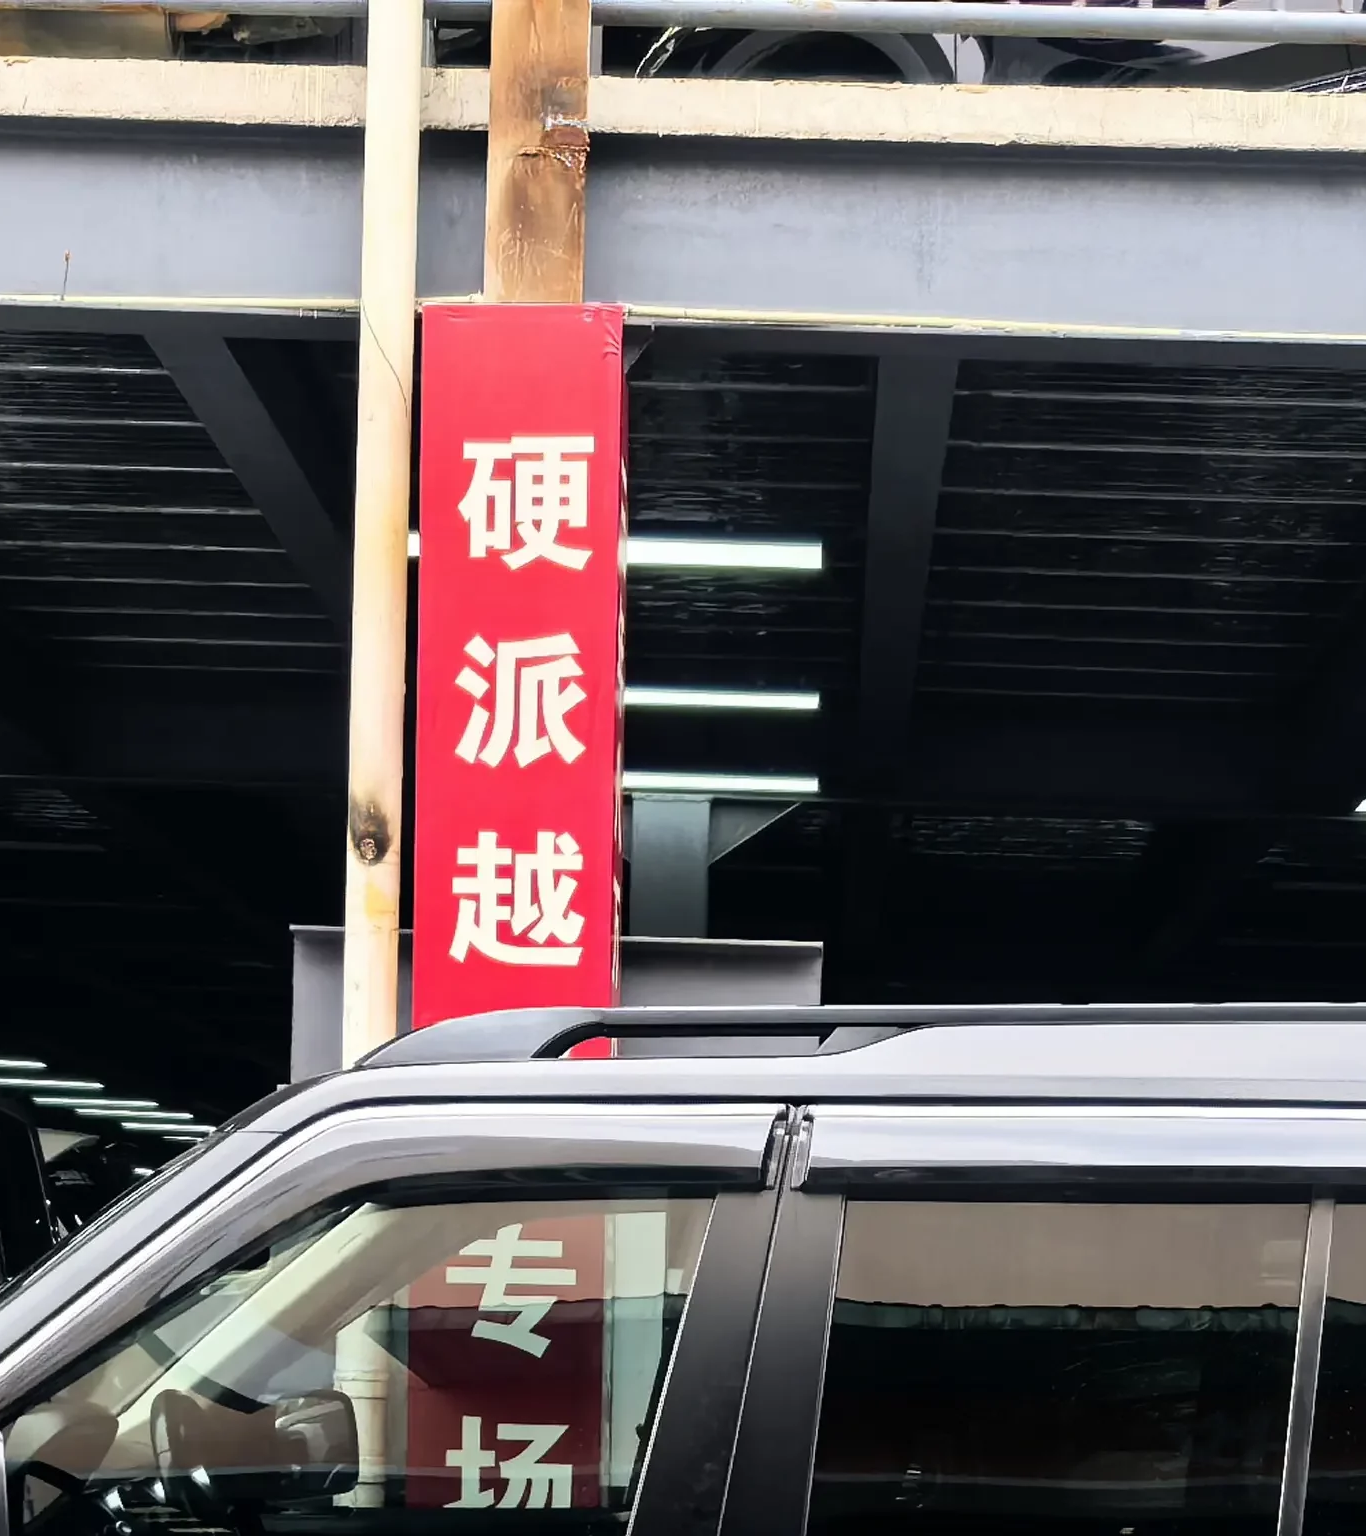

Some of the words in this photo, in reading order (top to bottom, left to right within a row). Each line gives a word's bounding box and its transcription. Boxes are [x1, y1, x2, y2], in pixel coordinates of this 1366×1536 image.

[449, 435, 595, 967] 硬派越
[443, 1223, 577, 1508] 专场
